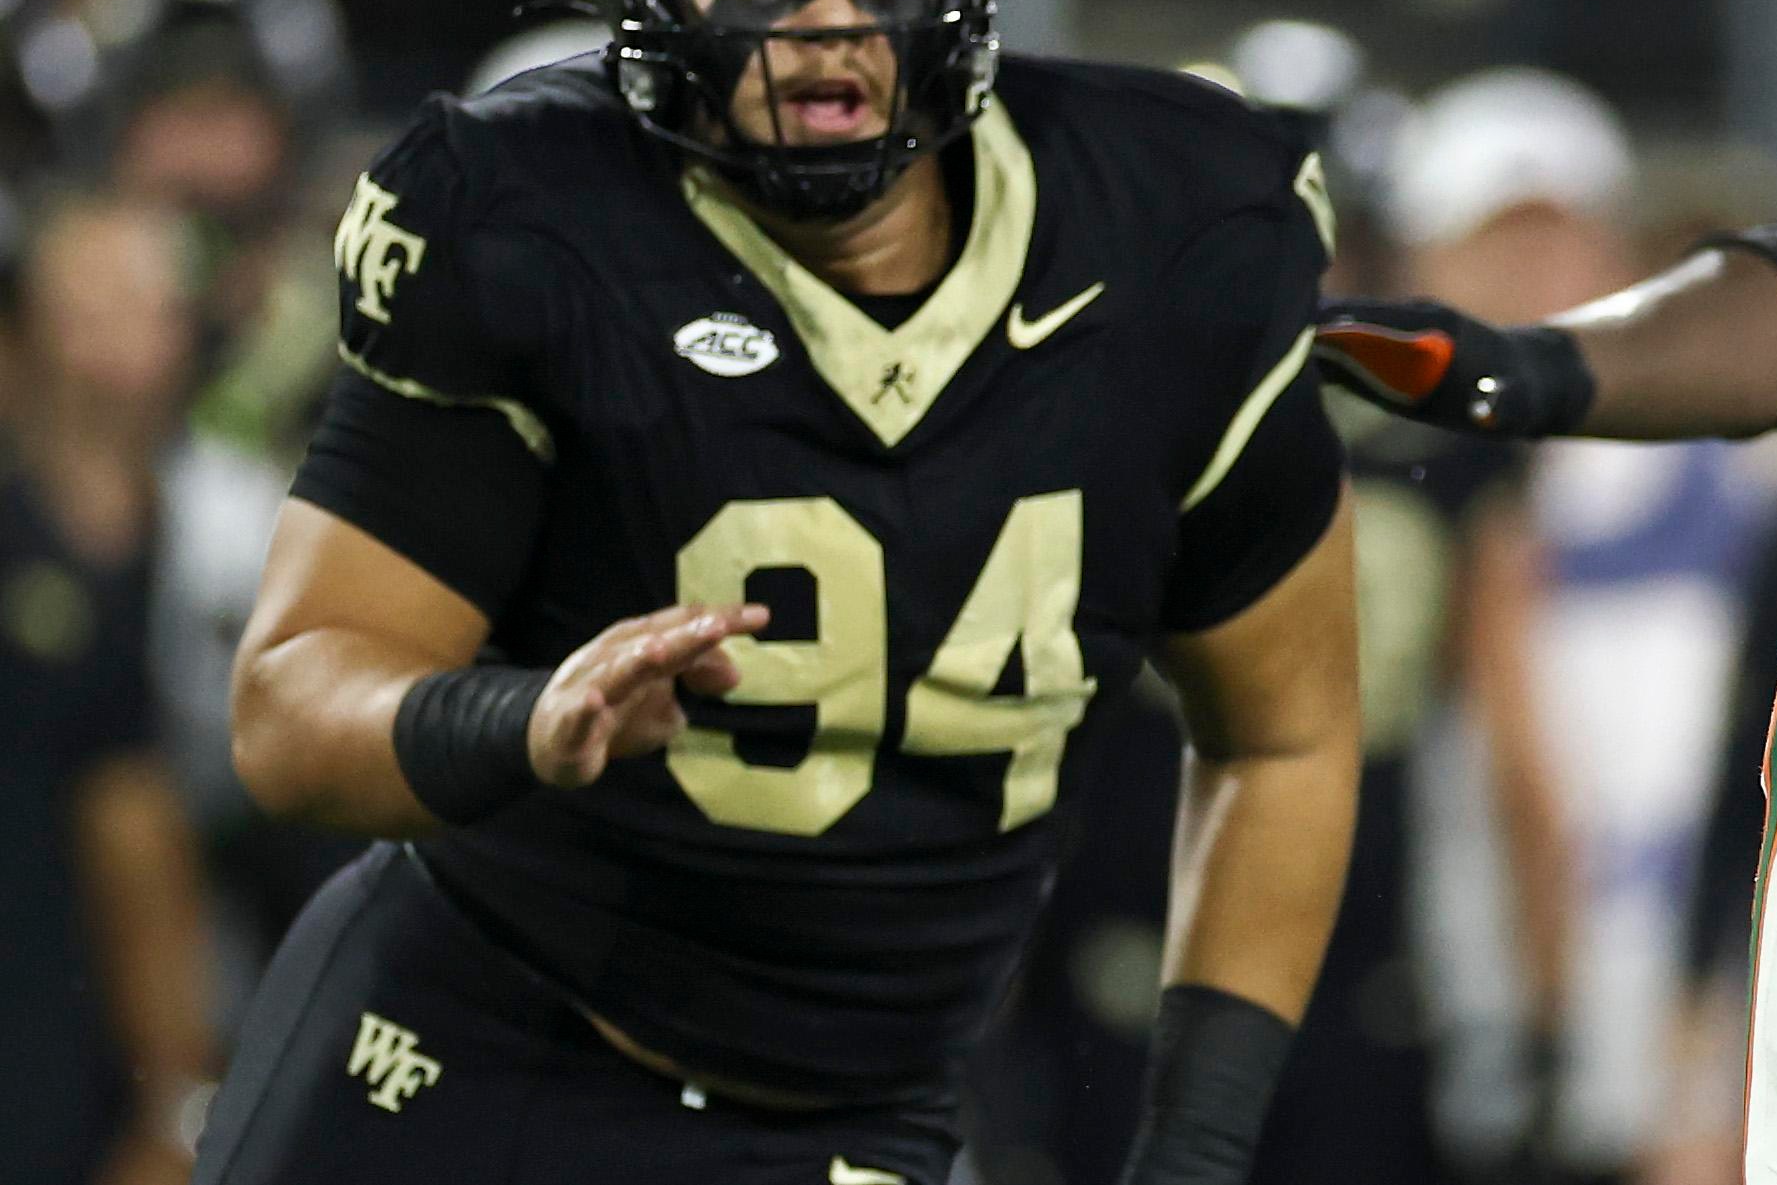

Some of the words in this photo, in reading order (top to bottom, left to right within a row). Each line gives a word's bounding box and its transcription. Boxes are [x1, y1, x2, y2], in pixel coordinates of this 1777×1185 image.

[683, 330, 767, 360] ACC
[665, 488, 1096, 837] 94
[346, 1011, 442, 1114] WF
